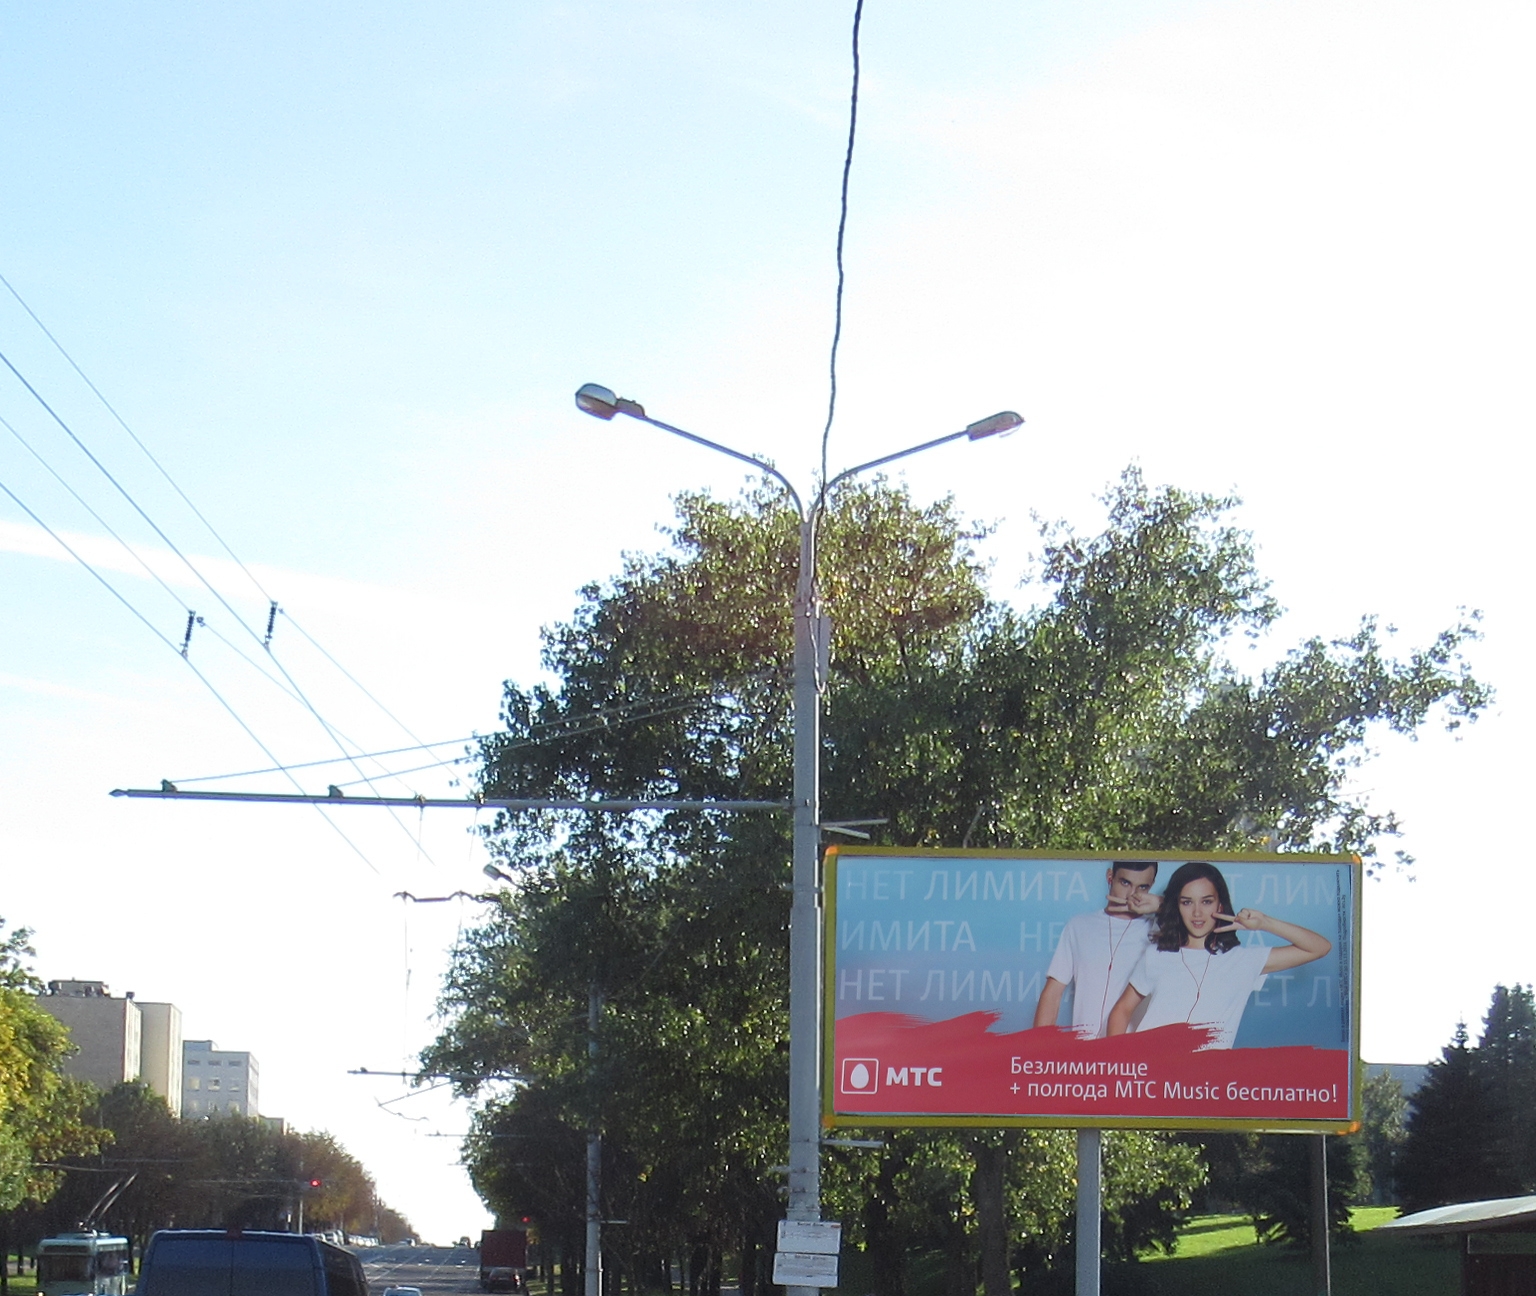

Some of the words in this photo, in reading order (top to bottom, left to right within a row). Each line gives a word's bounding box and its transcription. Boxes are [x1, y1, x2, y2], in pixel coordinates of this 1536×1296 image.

[845, 870, 914, 900] НЕТ
[924, 870, 1090, 901] ЛИМИТА
[842, 920, 977, 951] ИМИТА
[1019, 922, 1064, 952] НЕ
[839, 969, 910, 1001] НЕТ
[919, 970, 1070, 1002] ЛИМИ
[1254, 974, 1295, 1007] ЕТ
[885, 1067, 943, 1087] МТС
[1010, 1056, 1148, 1080] Безлимитище
[1027, 1082, 1108, 1101] полгода
[1115, 1081, 1157, 1099] МТС
[1163, 1081, 1220, 1101] Music
[1226, 1082, 1338, 1103] бесплатно!
